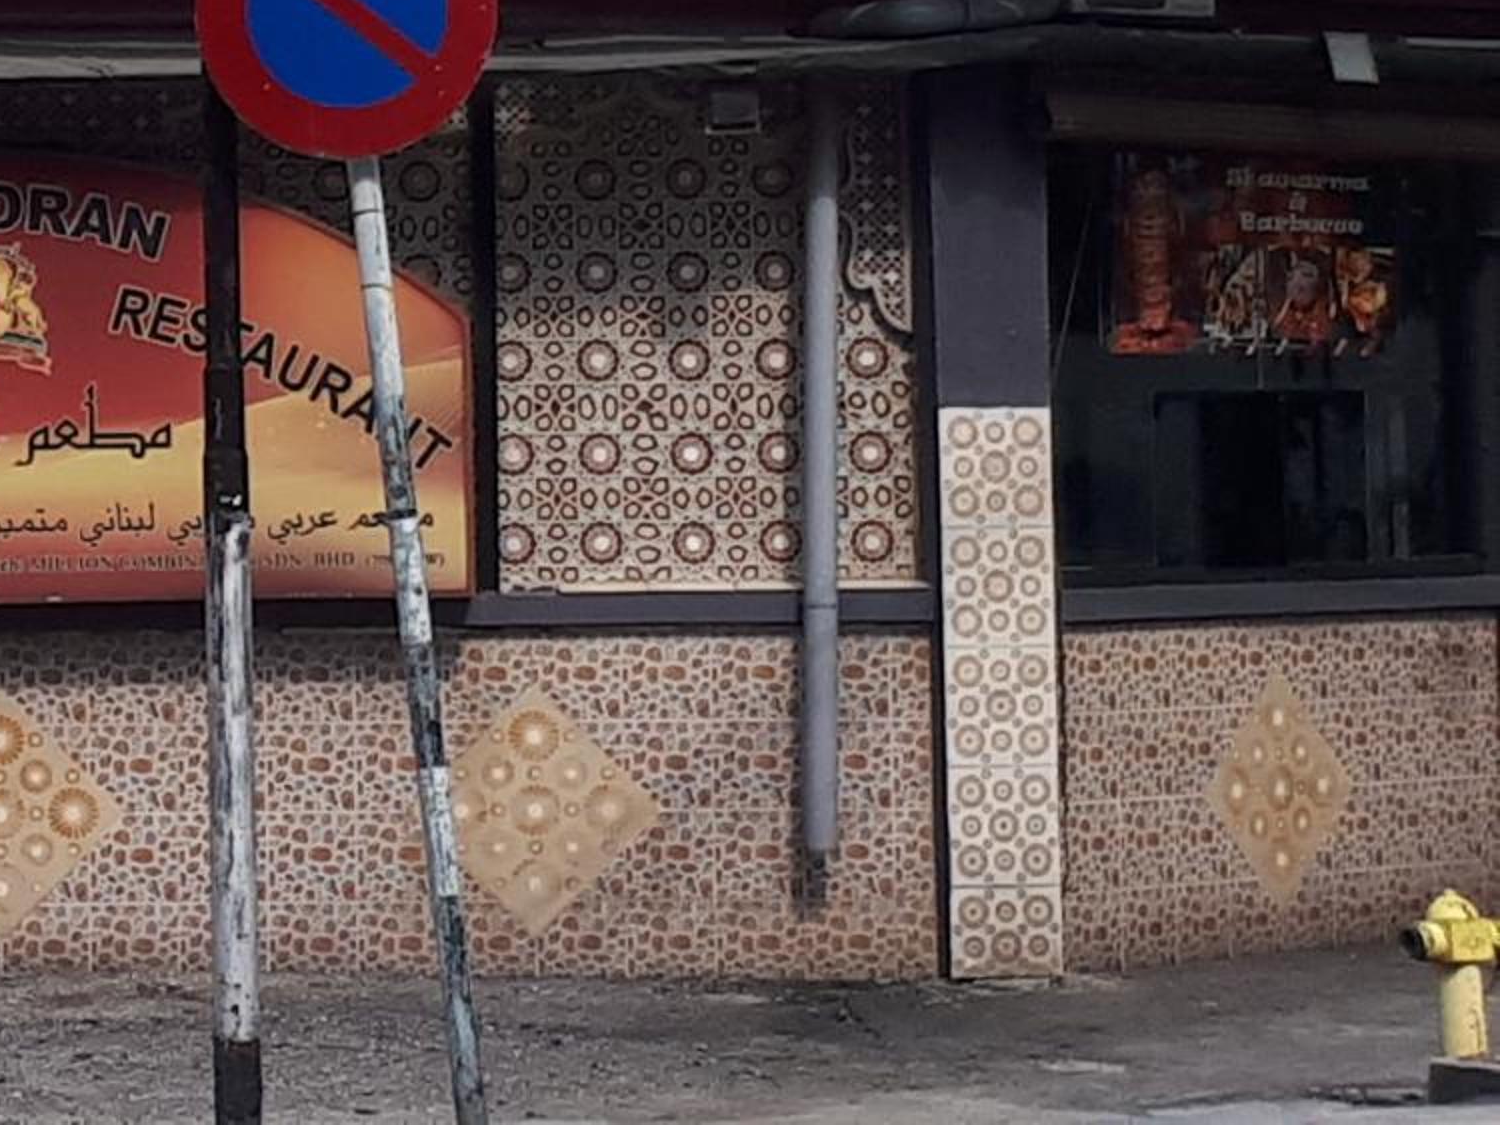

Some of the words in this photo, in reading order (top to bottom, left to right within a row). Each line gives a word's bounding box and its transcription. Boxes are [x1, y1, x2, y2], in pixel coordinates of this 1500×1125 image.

[112, 288, 453, 469] RESAURAT
[14, 383, 172, 467] مطعم
[80, 501, 156, 547] لبناني
[267, 510, 338, 545] عربي
[348, 509, 434, 531] معم
